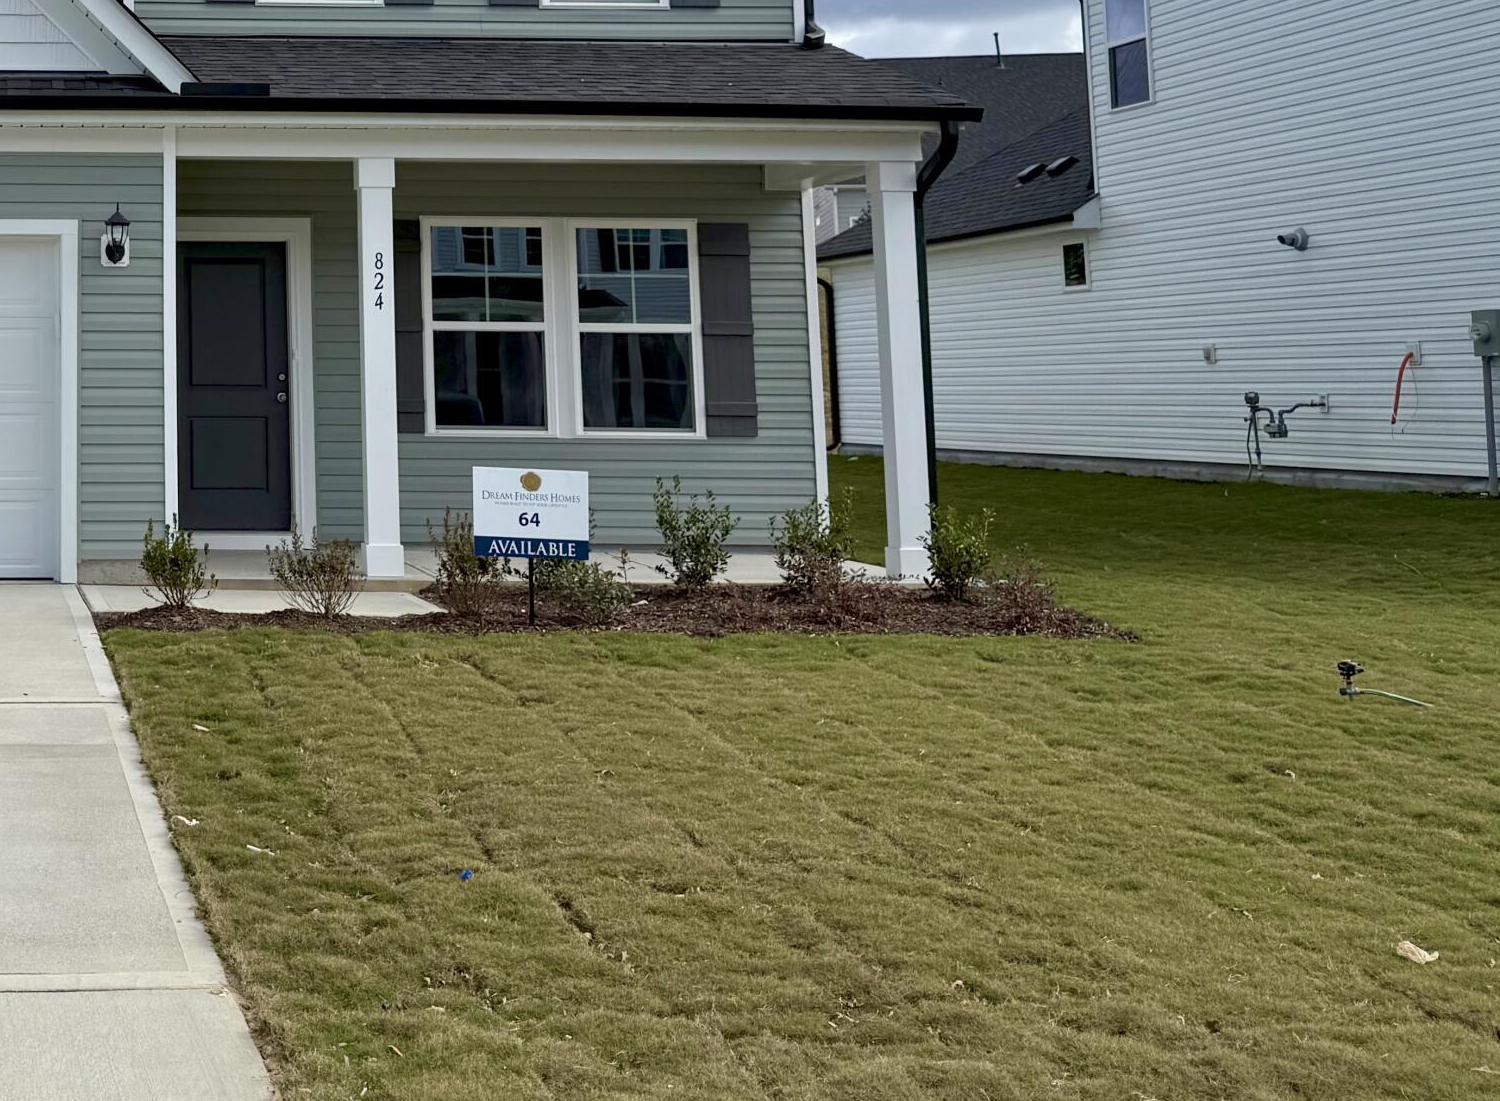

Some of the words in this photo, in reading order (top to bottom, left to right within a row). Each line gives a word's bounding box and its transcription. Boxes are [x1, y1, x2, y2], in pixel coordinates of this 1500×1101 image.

[374, 252, 384, 311] 824
[482, 490, 513, 500] DREAM
[515, 491, 549, 502] FINDERS
[550, 493, 581, 503] HOMES
[518, 512, 541, 527] 64
[488, 540, 576, 557] AVAILABLE
